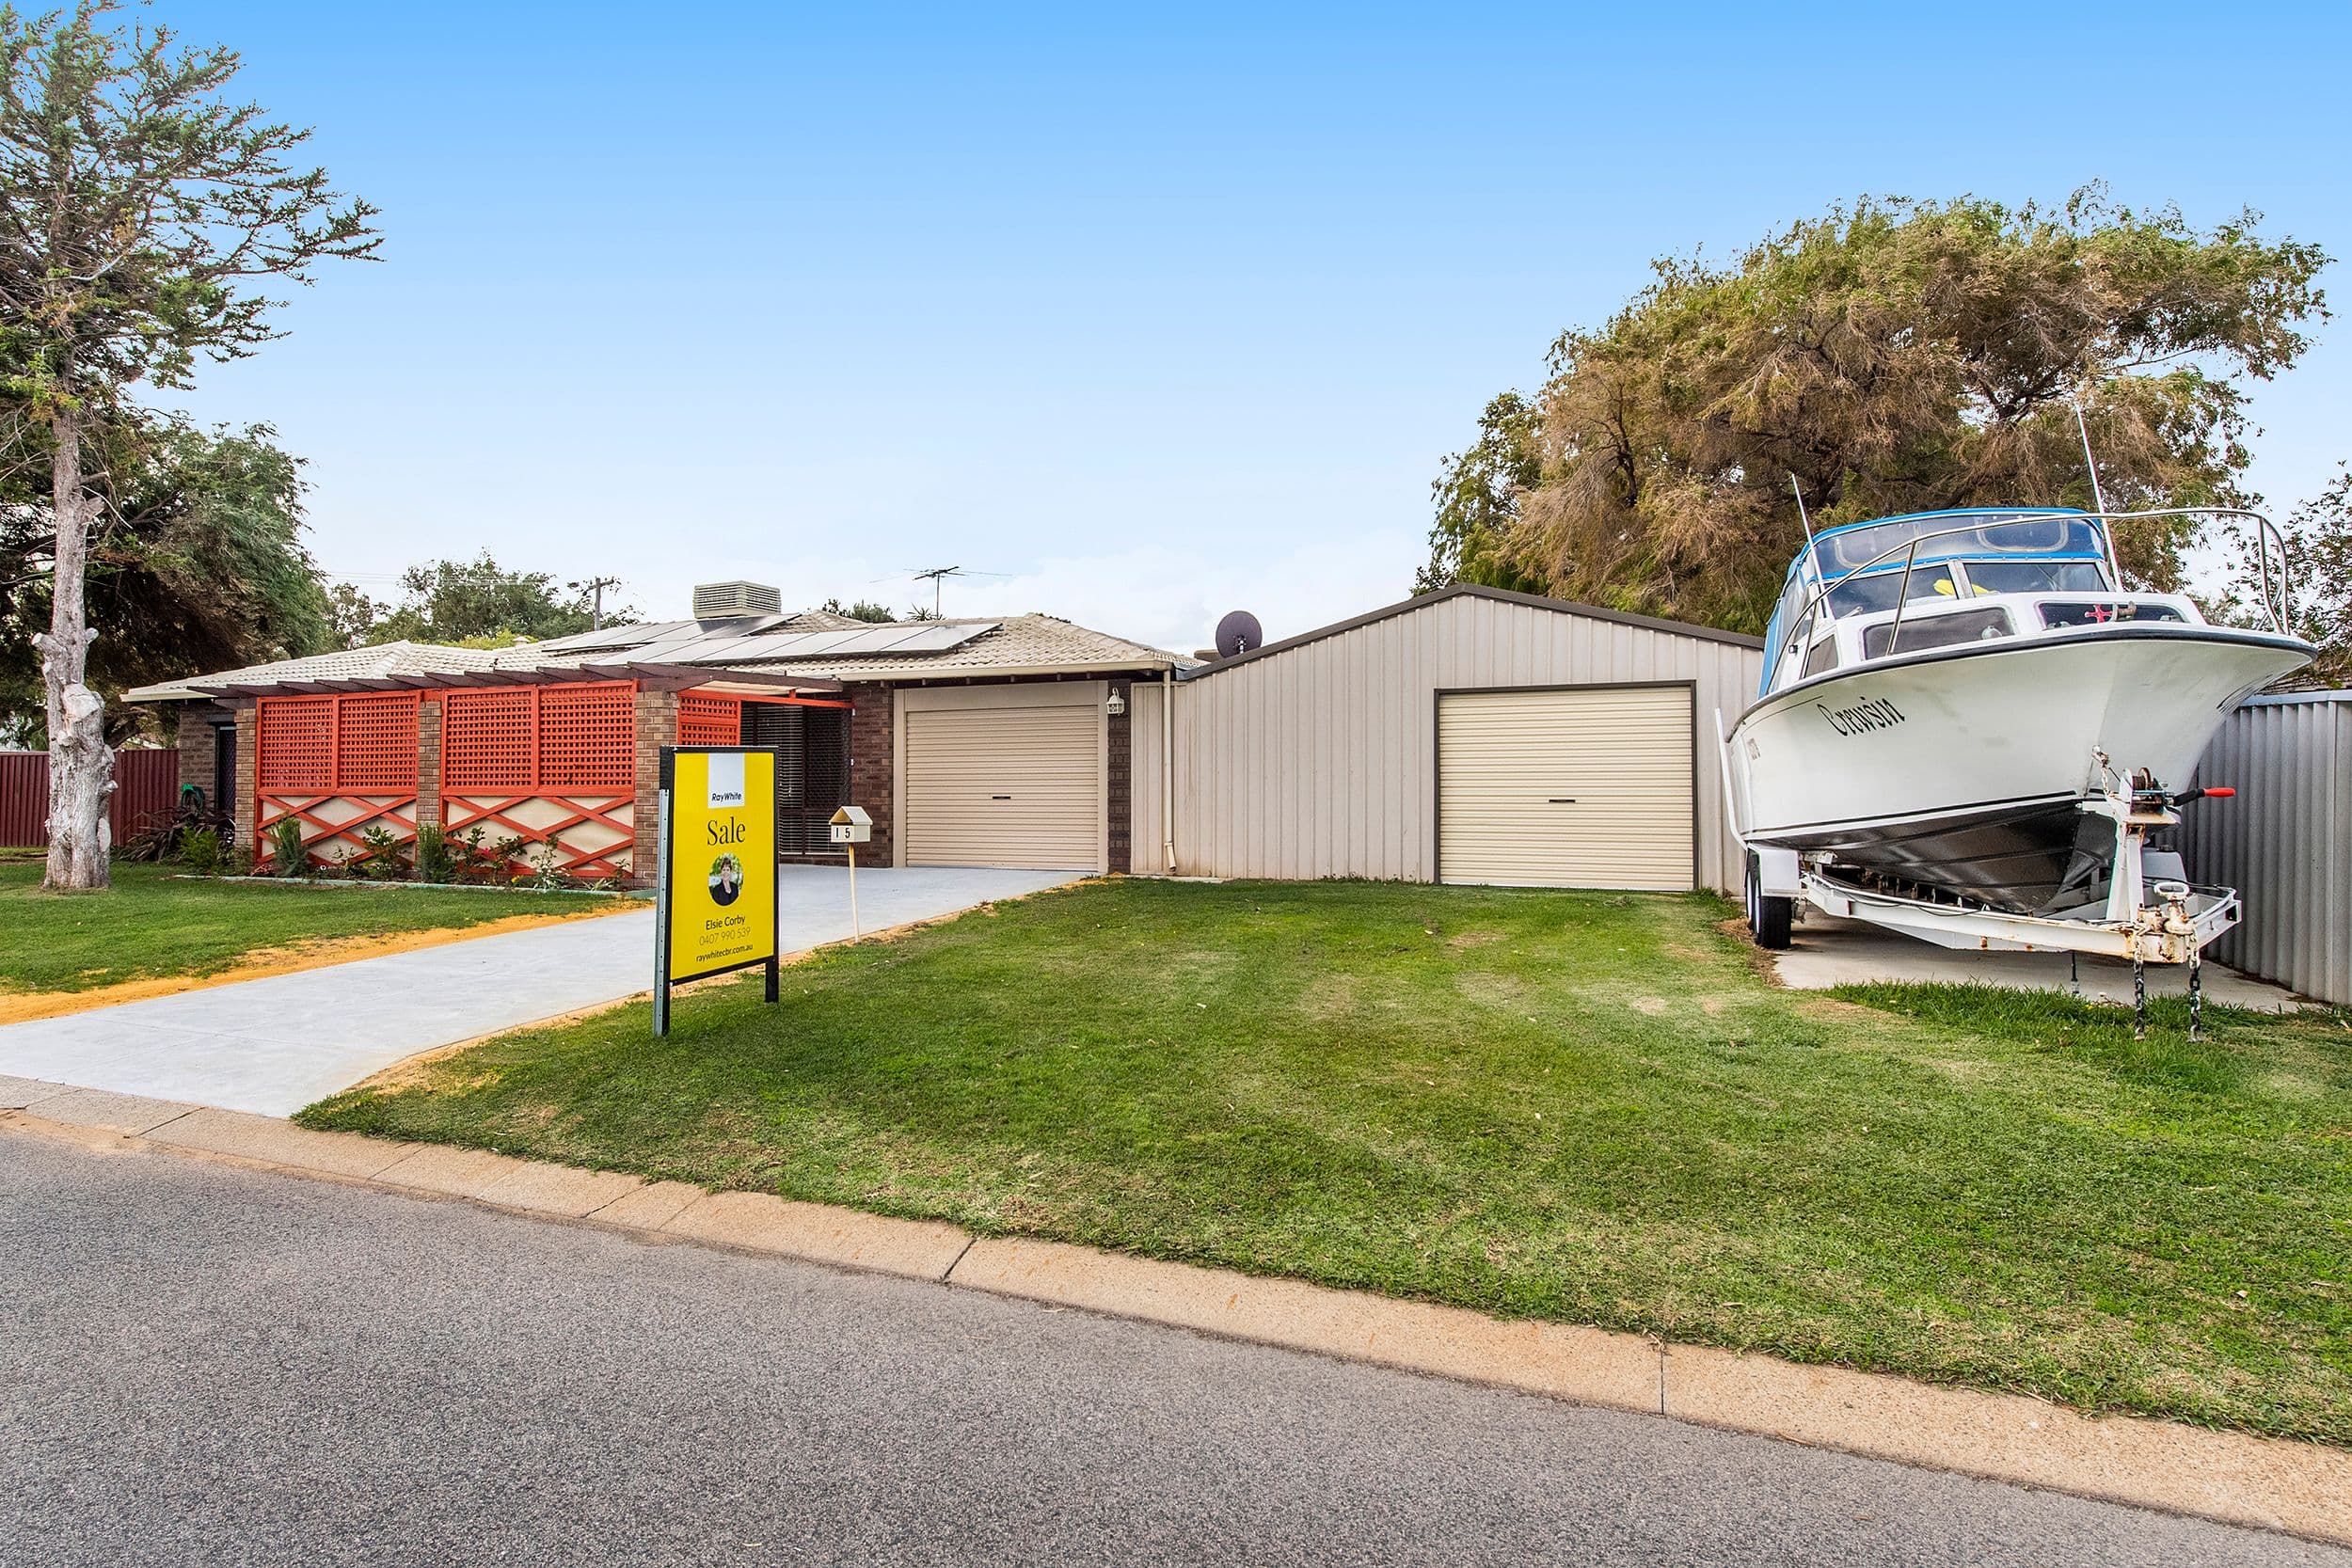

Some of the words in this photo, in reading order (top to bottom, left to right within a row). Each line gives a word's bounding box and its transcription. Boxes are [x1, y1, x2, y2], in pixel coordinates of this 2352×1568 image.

[707, 816, 746, 847] Sale
[706, 918, 723, 930] Elsie
[723, 914, 746, 927] Corby
[699, 932, 719, 946] 0407
[721, 929, 736, 942] 990
[737, 927, 751, 939] 539
[695, 944, 754, 962] raywhitecbr.com.au
